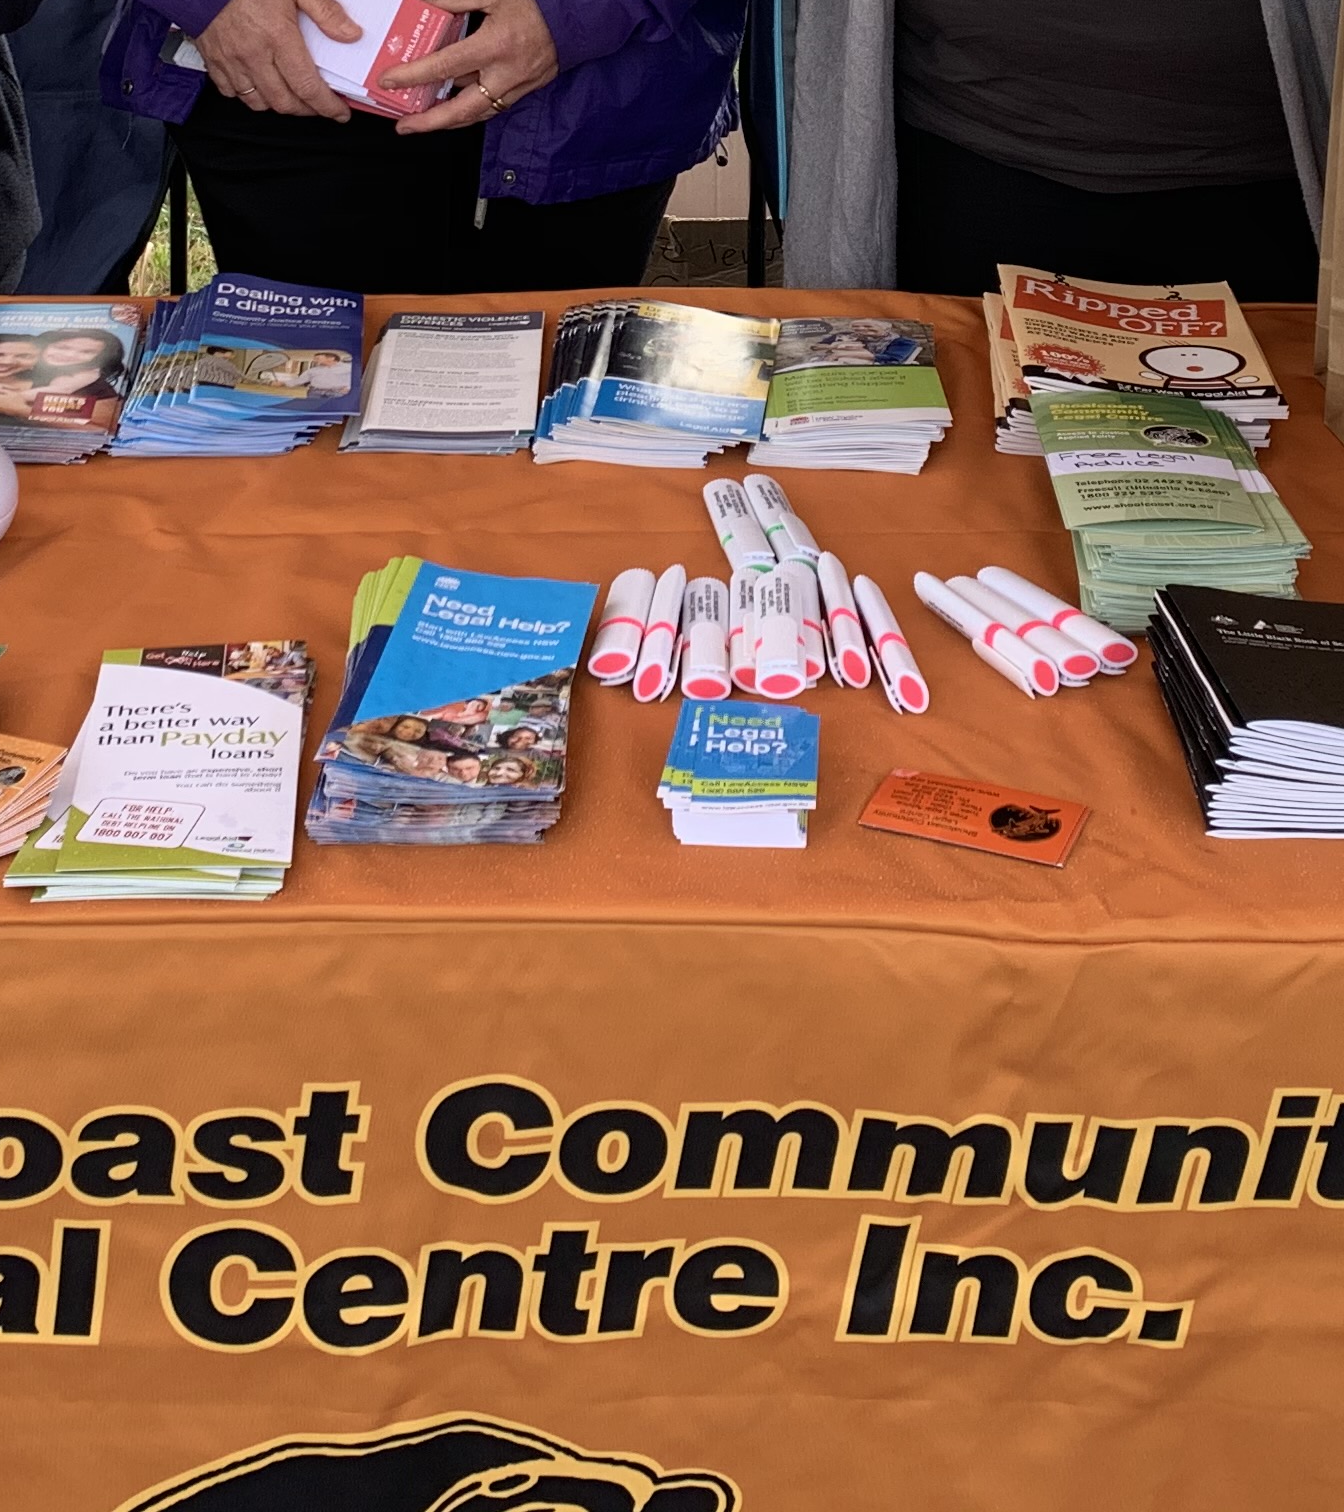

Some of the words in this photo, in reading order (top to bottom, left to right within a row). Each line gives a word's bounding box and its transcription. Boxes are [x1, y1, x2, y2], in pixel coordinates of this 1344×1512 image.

[401, 19, 425, 63] PHILLIPS
[419, 8, 431, 23] MP
[217, 283, 303, 306] Dealing
[310, 297, 357, 308] with
[1022, 279, 1201, 320] Ripped
[214, 297, 229, 306] a
[236, 299, 336, 316] dispute?
[468, 314, 531, 322] VIOLENCE
[1118, 318, 1224, 337] OFF?
[1155, 388, 1185, 397] West
[1106, 414, 1164, 422] Centre
[1058, 451, 1127, 461] Free
[1136, 451, 1196, 462] Legal
[1074, 459, 1165, 469] Advice
[1083, 501, 1215, 511] www.shoalcoast.org.au
[426, 593, 496, 617] Need
[422, 604, 494, 627] Legal
[498, 617, 571, 635] Help?
[533, 639, 560, 647] NSW
[1216, 628, 1234, 636] The
[1236, 630, 1264, 639] Little
[1265, 634, 1293, 642] Black
[1294, 637, 1319, 645] Book
[181, 649, 207, 658] Help
[103, 701, 192, 718] There's
[99, 721, 114, 732] a
[124, 716, 200, 732] better
[209, 715, 261, 728] way
[709, 714, 782, 727] Need
[98, 732, 155, 746] than
[159, 728, 288, 749] Payday
[707, 727, 784, 741] Legal
[211, 748, 275, 760] loans
[706, 740, 788, 756] Help?
[121, 804, 143, 812] FOR
[143, 816, 184, 824] NATIONAL
[93, 828, 121, 838] 1800
[123, 830, 147, 840] 007
[148, 832, 173, 842] 007
[163, 1221, 788, 1351] Centre
[839, 1217, 1191, 1346] Inc.
